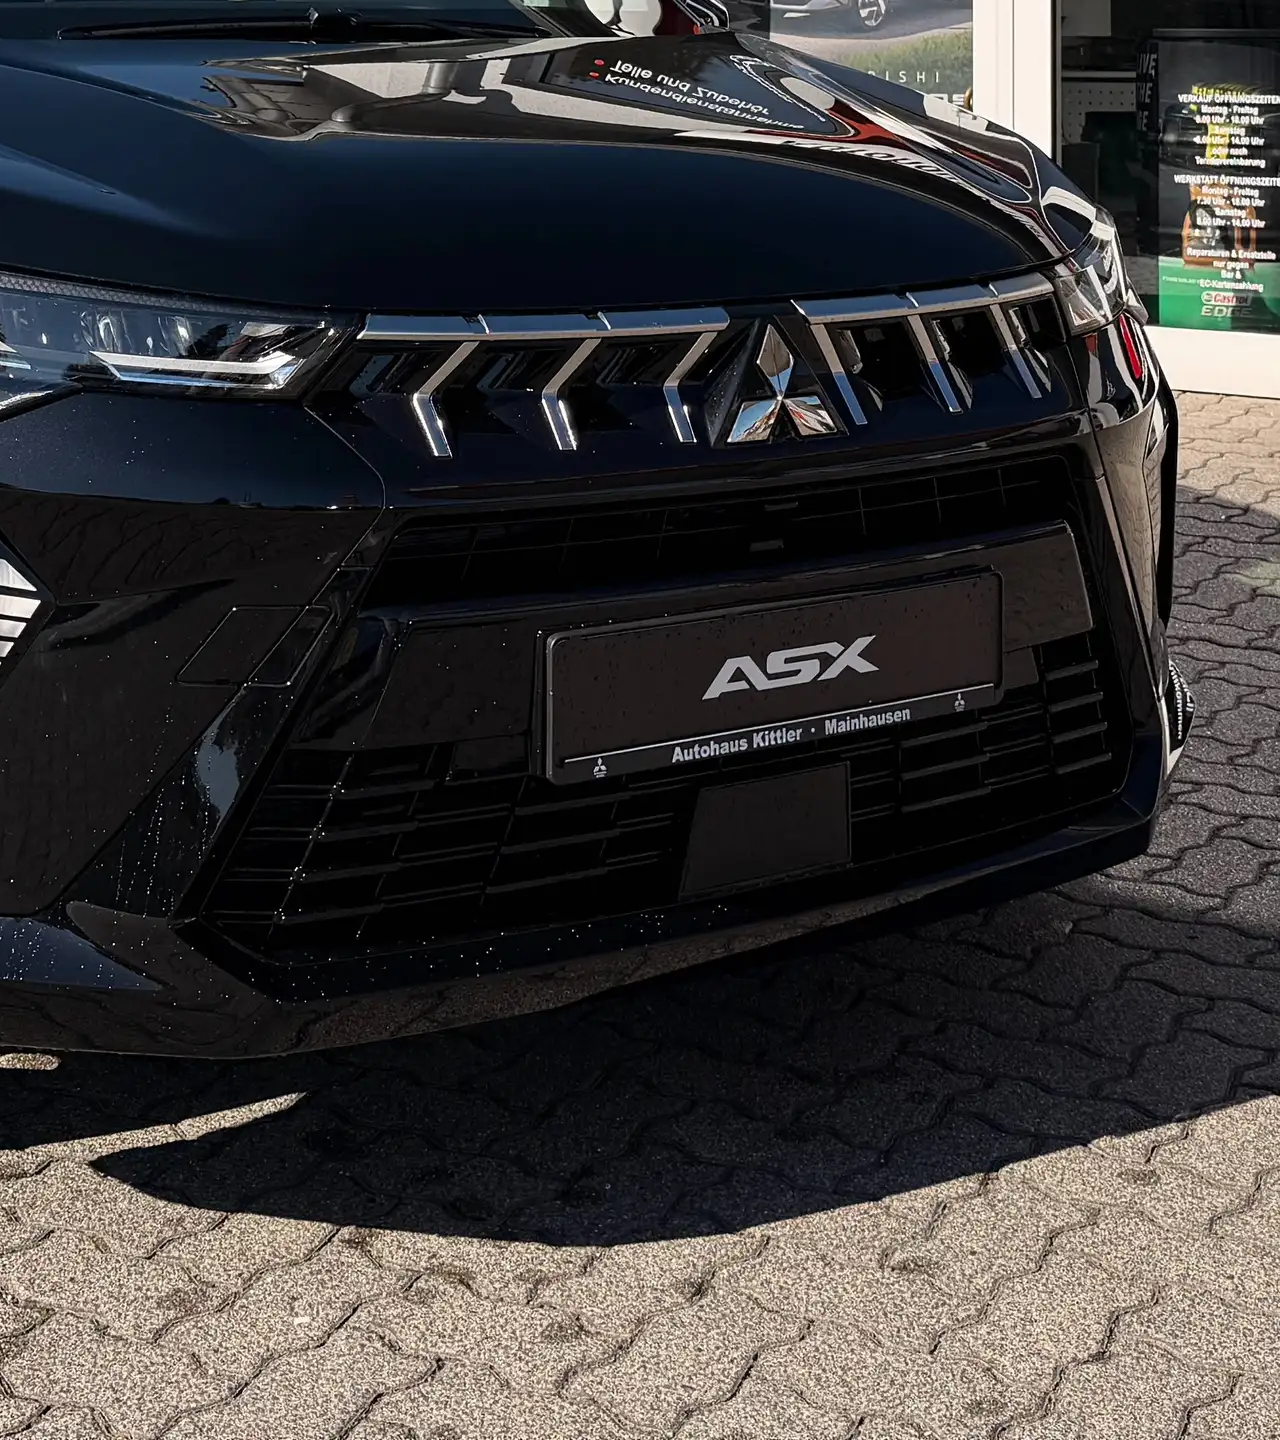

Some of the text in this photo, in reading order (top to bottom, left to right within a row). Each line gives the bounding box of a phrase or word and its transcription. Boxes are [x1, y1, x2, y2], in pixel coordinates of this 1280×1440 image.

[1201, 305, 1252, 317] EDGE
[1213, 293, 1249, 305] Castrol
[701, 634, 880, 701] ASX
[671, 707, 911, 763] Autohaus Kittler Mainhausen
